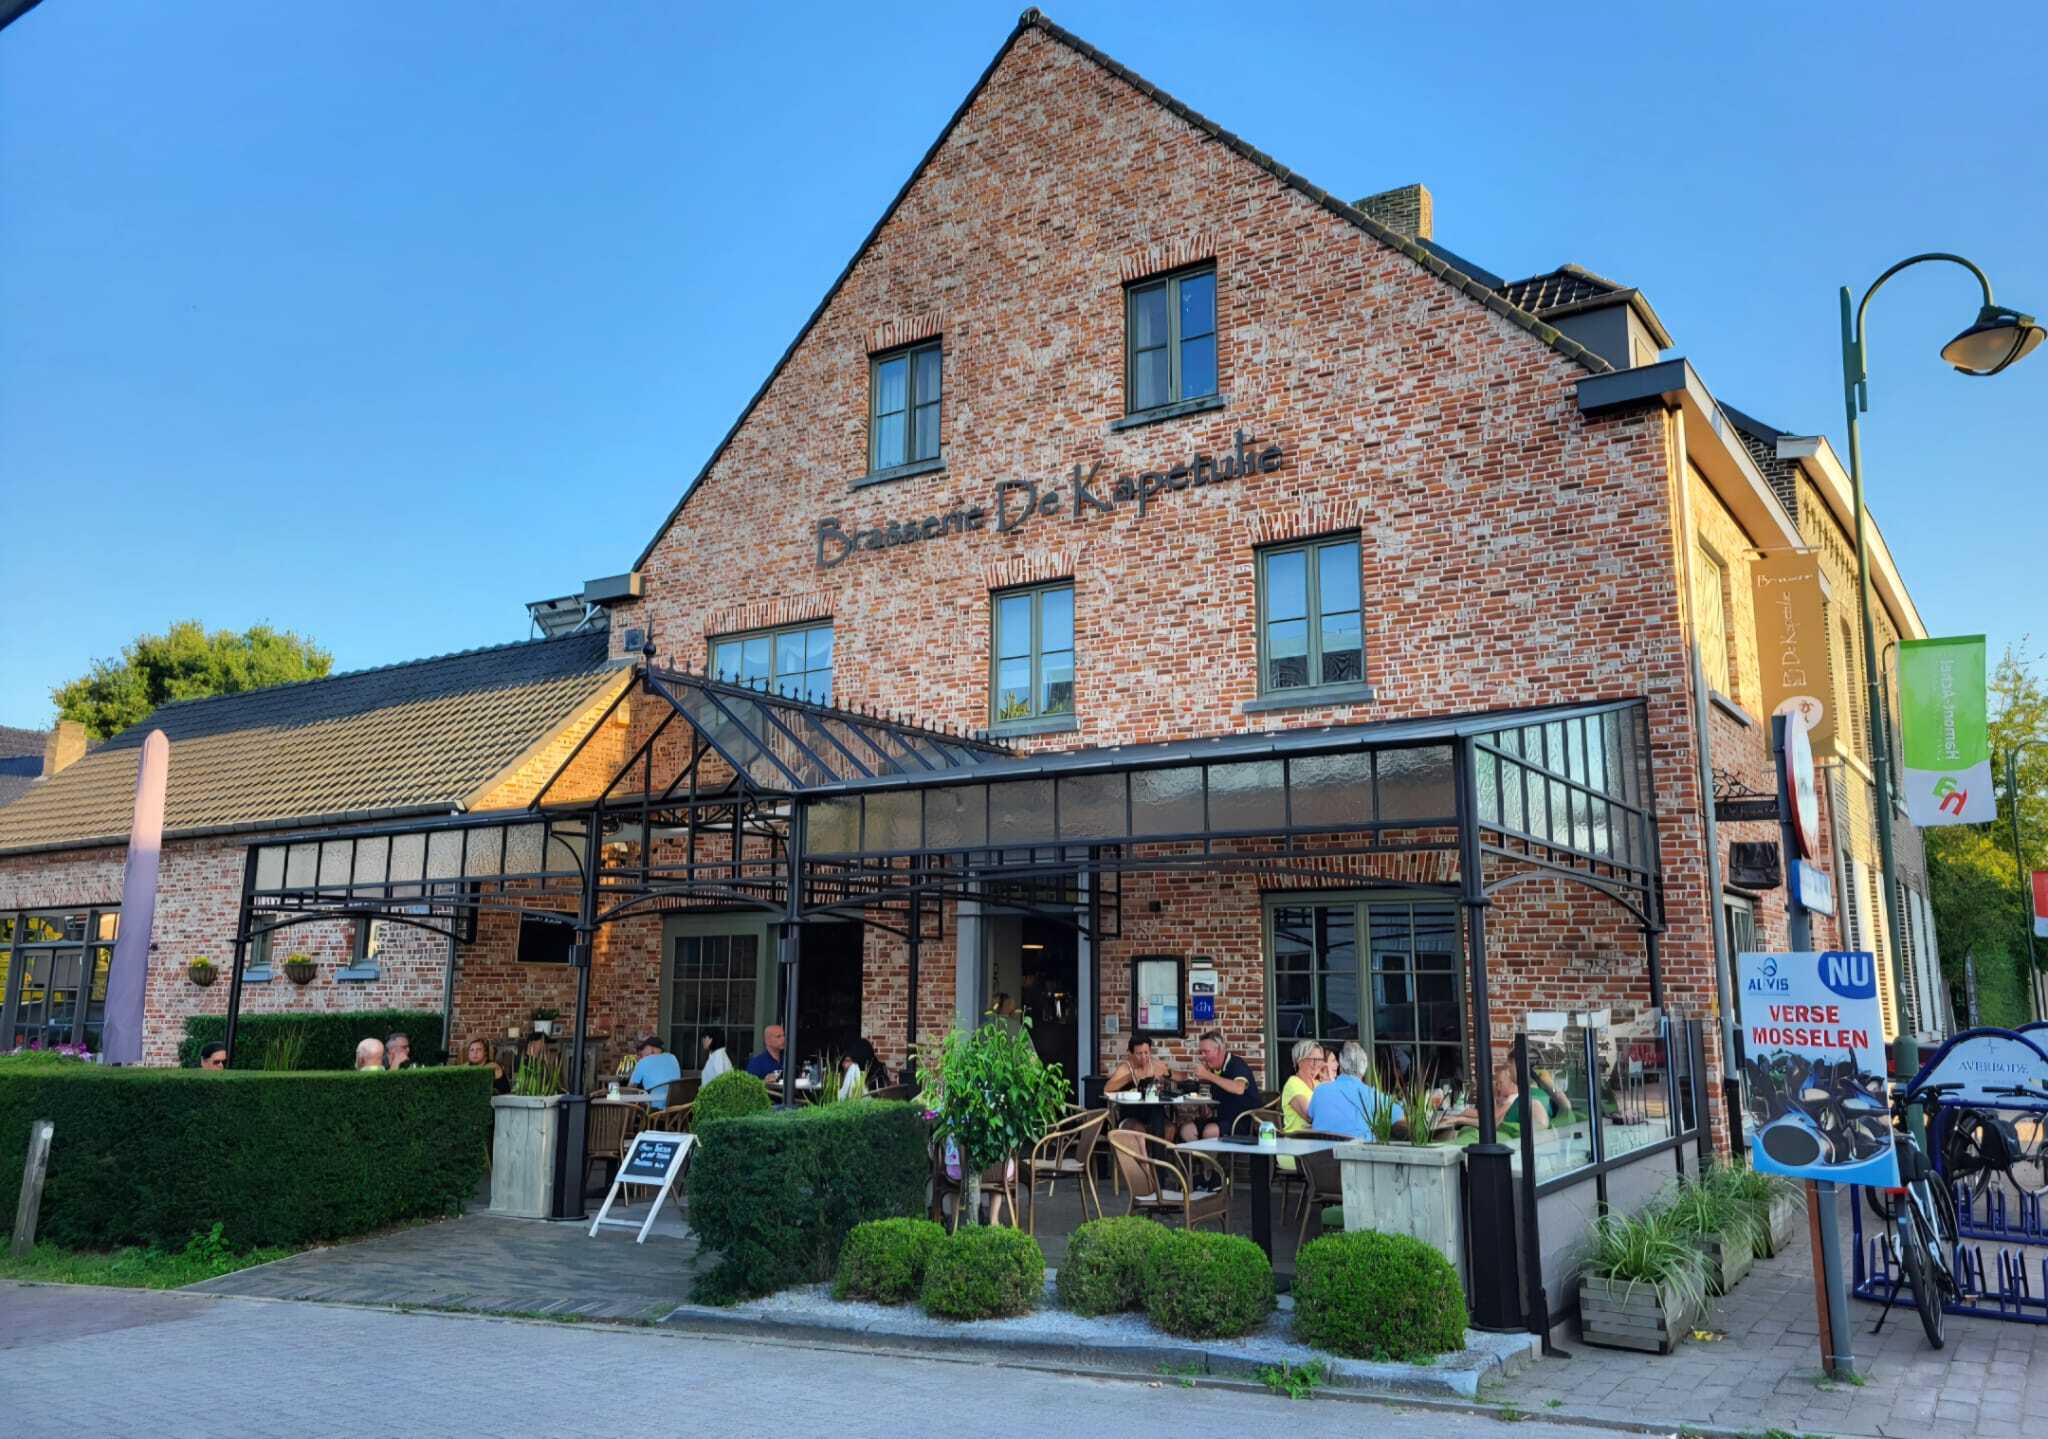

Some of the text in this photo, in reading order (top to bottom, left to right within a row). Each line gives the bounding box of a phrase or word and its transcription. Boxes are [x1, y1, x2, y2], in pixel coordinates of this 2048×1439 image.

[816, 429, 1283, 568] Brasserie De Kapetulie
[1827, 956, 1869, 987] NU
[1769, 1005, 1840, 1024] VERSE
[1753, 1028, 1869, 1049] MOSSELEN
